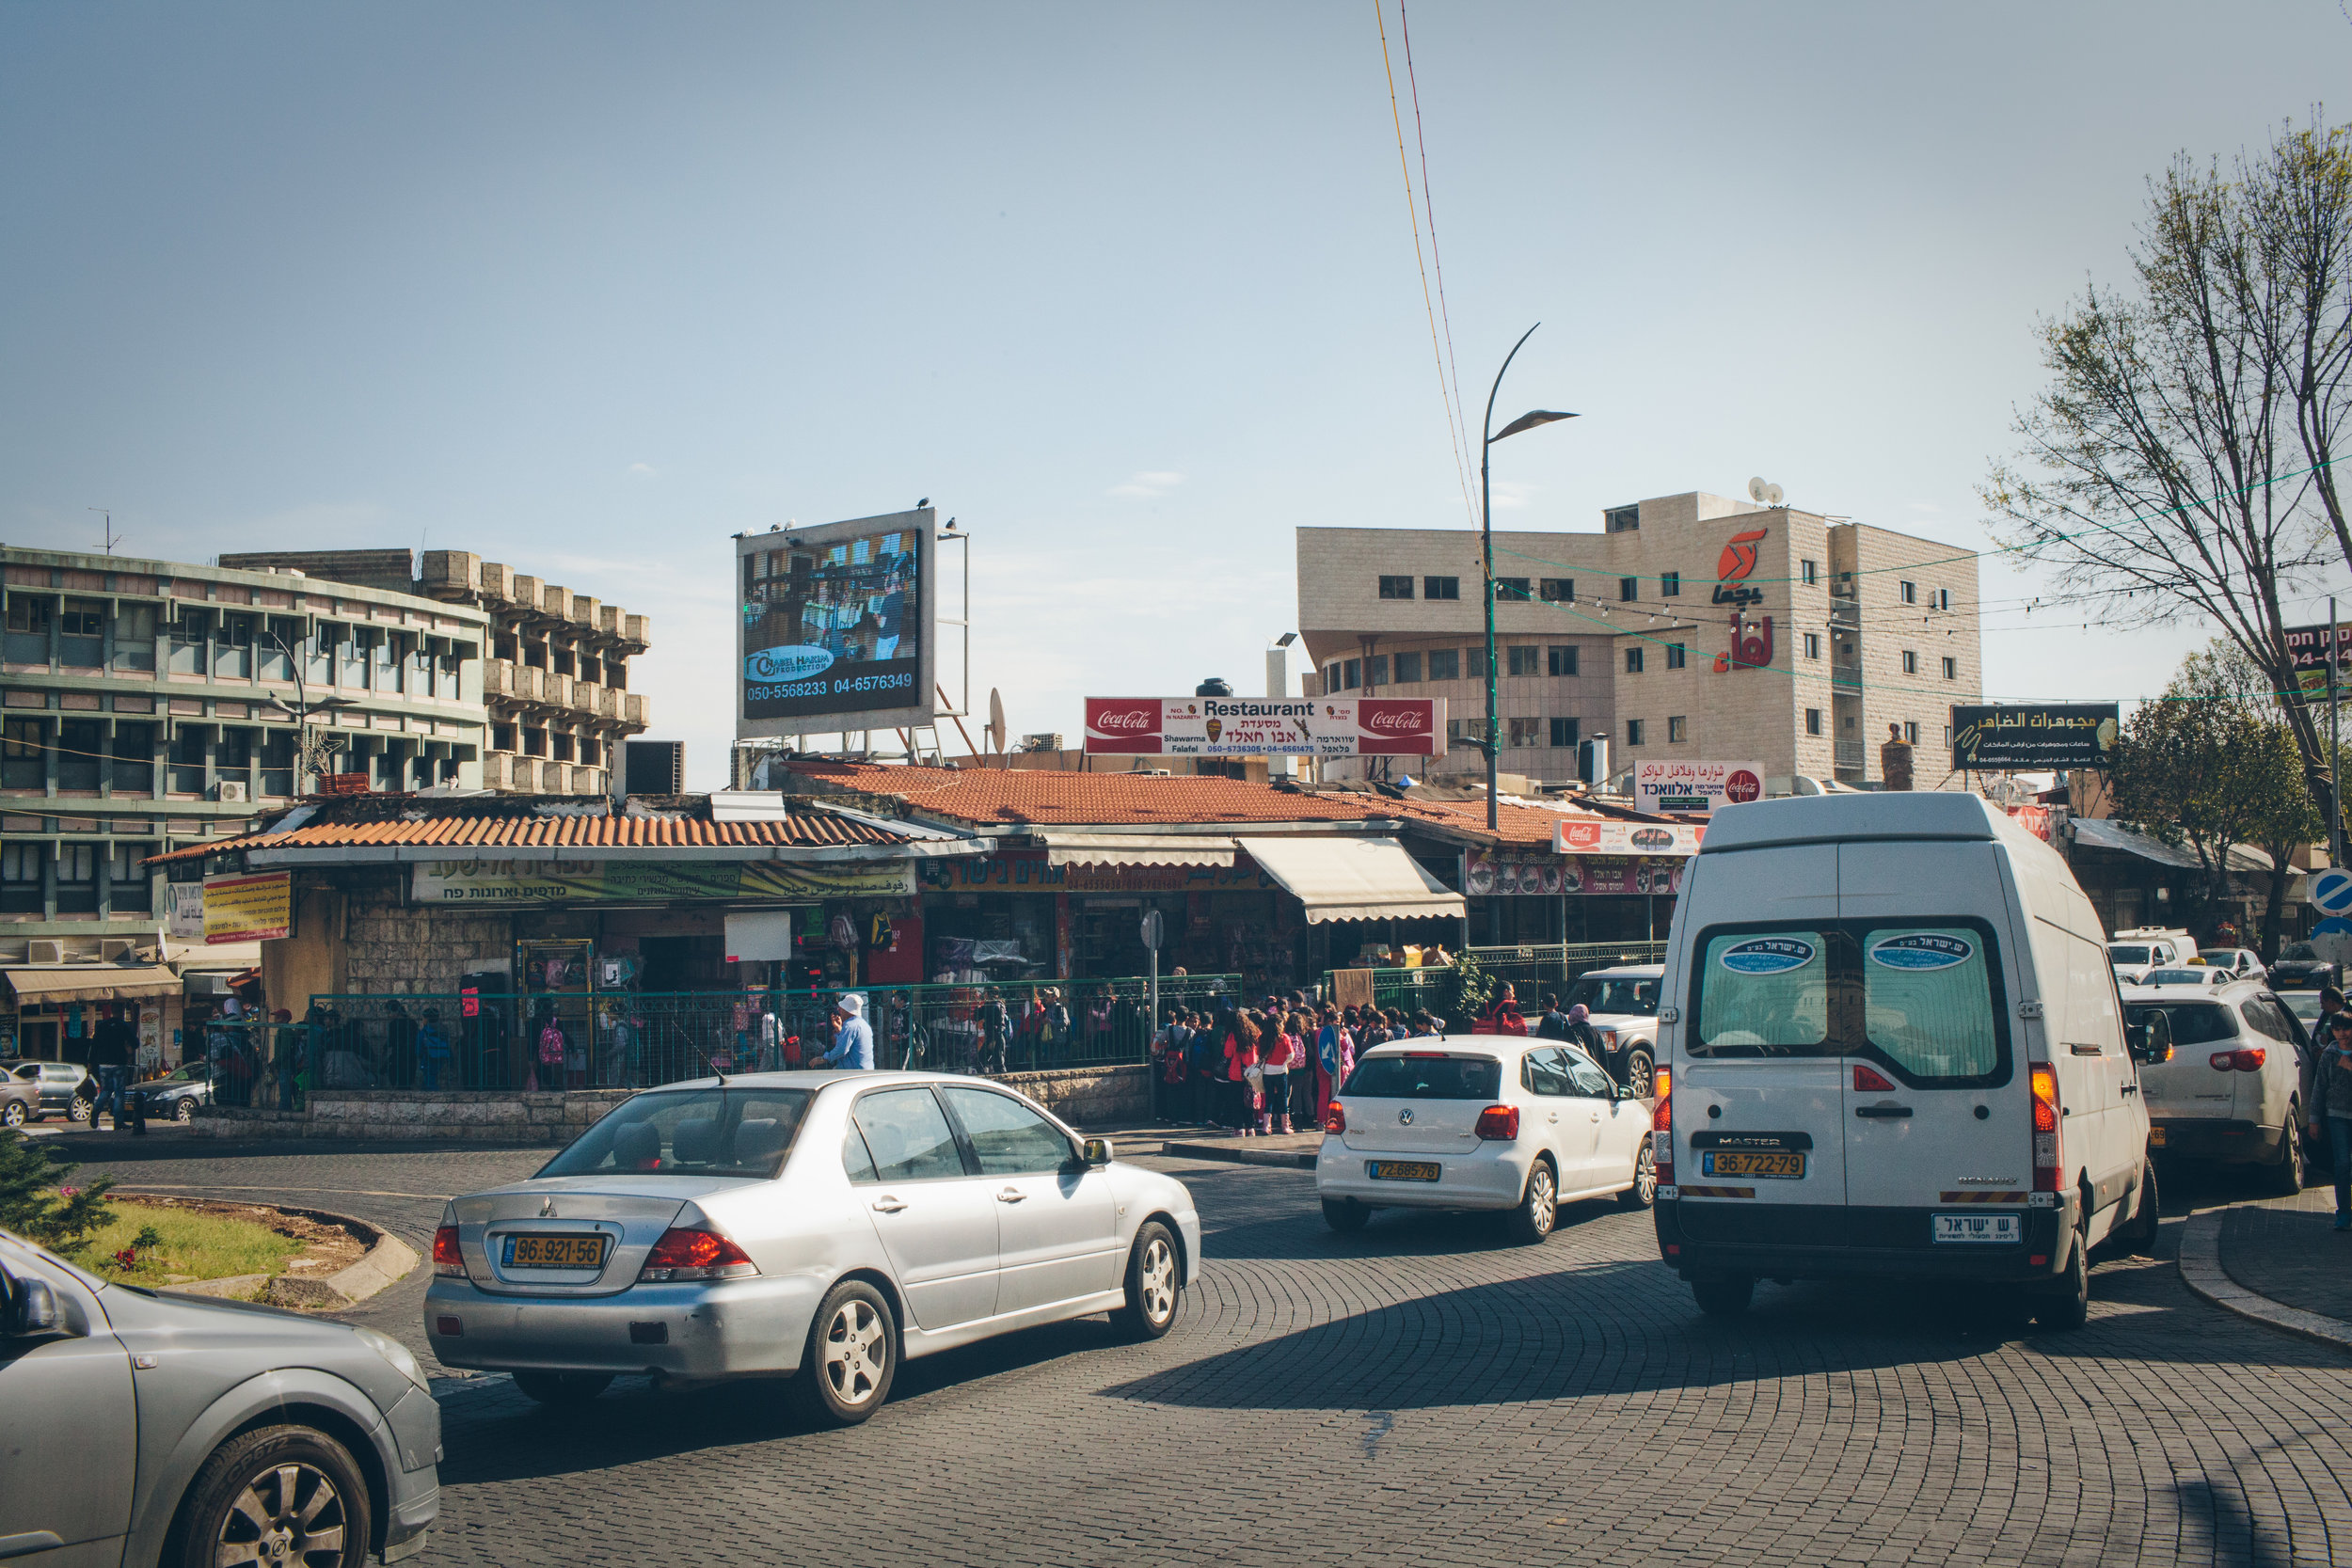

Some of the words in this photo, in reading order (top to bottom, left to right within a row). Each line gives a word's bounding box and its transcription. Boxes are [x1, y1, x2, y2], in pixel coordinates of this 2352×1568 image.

[776, 662, 826, 673] PRODUCTION
[747, 681, 827, 701] 050-5568233
[834, 673, 913, 694] 04-6576349
[1204, 700, 1314, 716] Restaurant
[1240, 720, 1281, 728] מסעדת
[1977, 712, 2026, 730] الضاهر
[2030, 712, 2096, 730] مجوهرات
[1225, 728, 1264, 743] חאלד
[1271, 731, 1296, 743] אבו
[1641, 781, 1692, 796] אלוואכד
[1486, 853, 1522, 863] AL-AMAL
[611, 875, 637, 884] כתיבה
[640, 874, 669, 884] מכשירי
[710, 874, 736, 882] ספרים
[1612, 870, 1622, 879] אבו
[469, 887, 518, 898] וארונות
[523, 885, 566, 897] מדפים
[881, 879, 909, 893] رفوف
[1608, 882, 1625, 891] חומוס
[444, 888, 464, 899] פח
[1765, 941, 1806, 954] ש.ישראל
[1919, 937, 1963, 952] ש.ישראל
[1718, 1155, 1800, 1173] 36-722-79
[1944, 1217, 1989, 1232] ישראל
[1997, 1218, 2010, 1232] ש
[517, 1239, 598, 1262] 96-921-56
